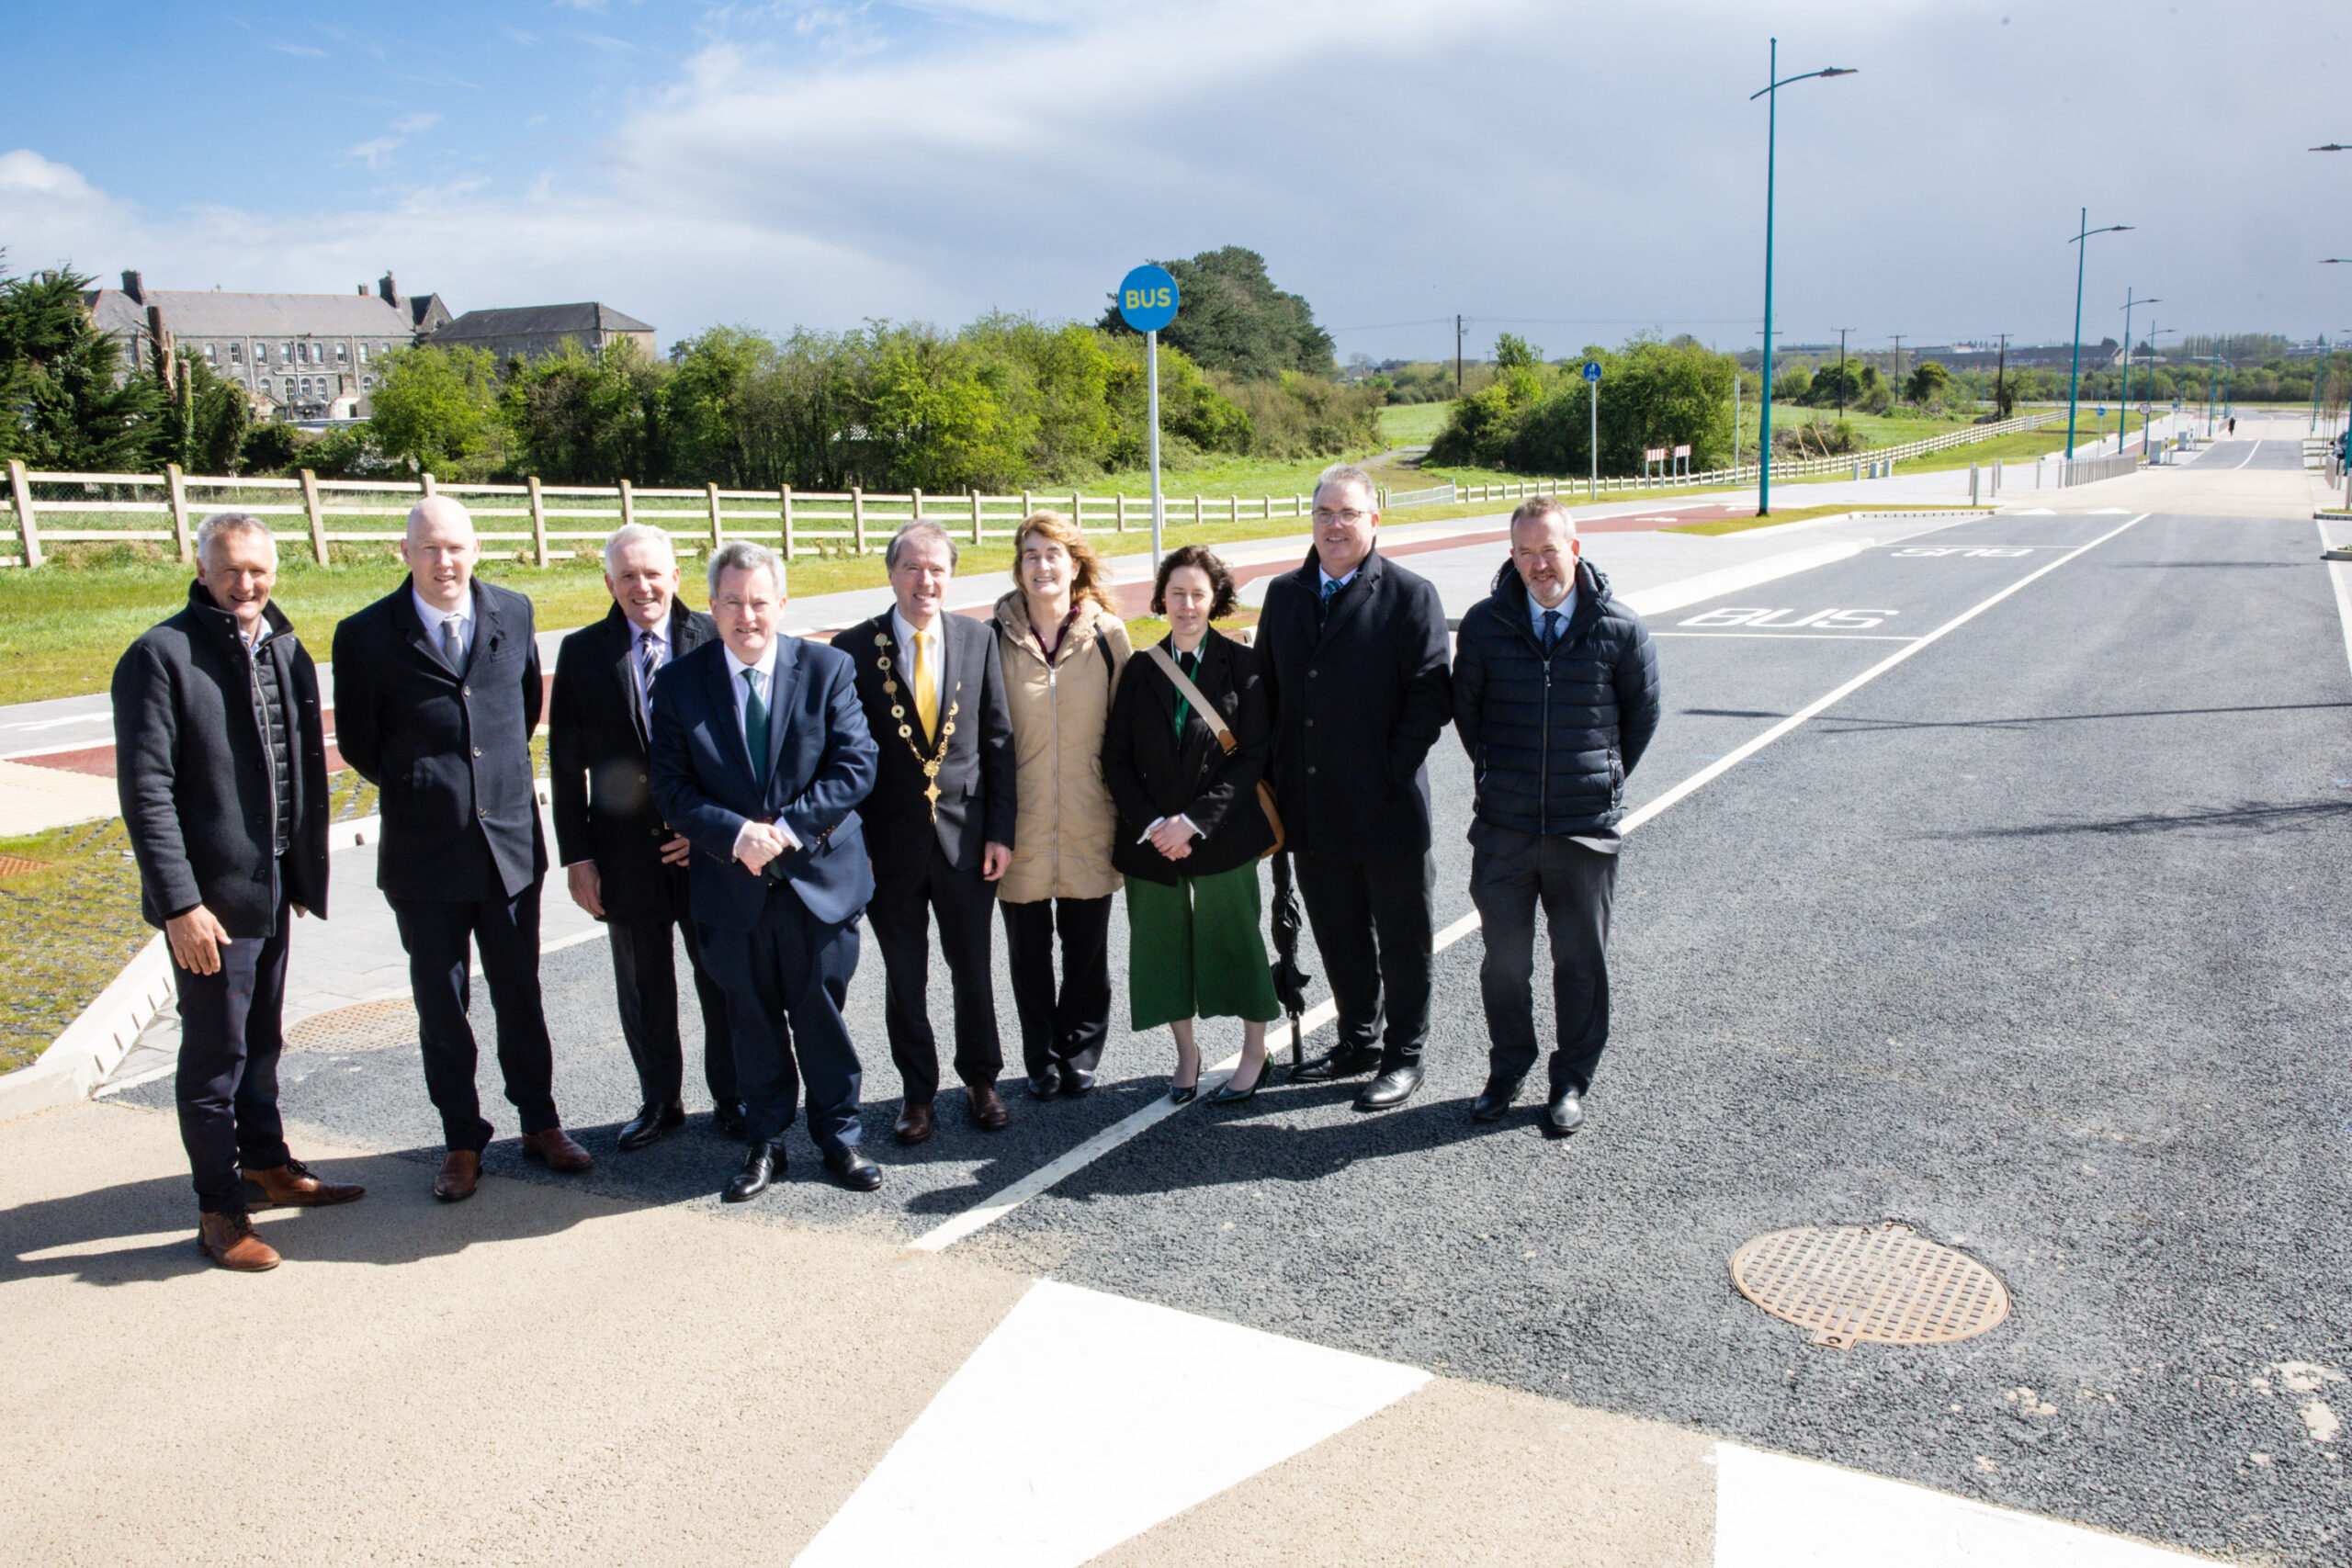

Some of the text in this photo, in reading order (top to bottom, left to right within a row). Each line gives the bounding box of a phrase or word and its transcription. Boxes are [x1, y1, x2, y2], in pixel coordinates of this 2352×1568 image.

[1125, 288, 1171, 310] BUS
[1890, 547, 2034, 557] BUS
[1677, 607, 1900, 629] BUS
